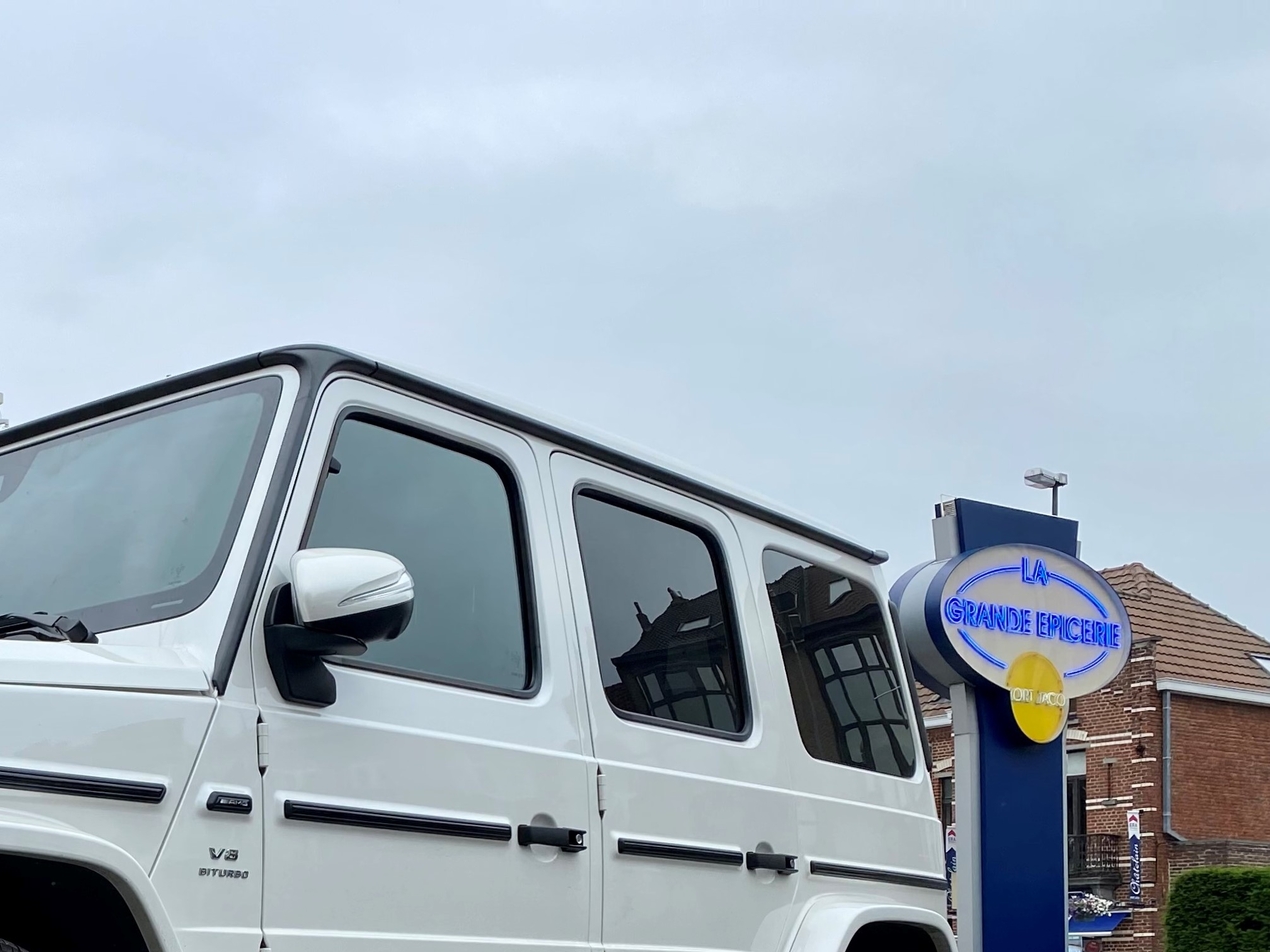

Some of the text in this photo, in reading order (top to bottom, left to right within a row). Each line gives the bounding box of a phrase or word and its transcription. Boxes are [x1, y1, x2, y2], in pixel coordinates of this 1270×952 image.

[1021, 557, 1050, 586] LA
[944, 596, 1121, 648] GRANDE EPICERIE
[208, 848, 239, 861] V8
[198, 867, 249, 879] BITURBO
